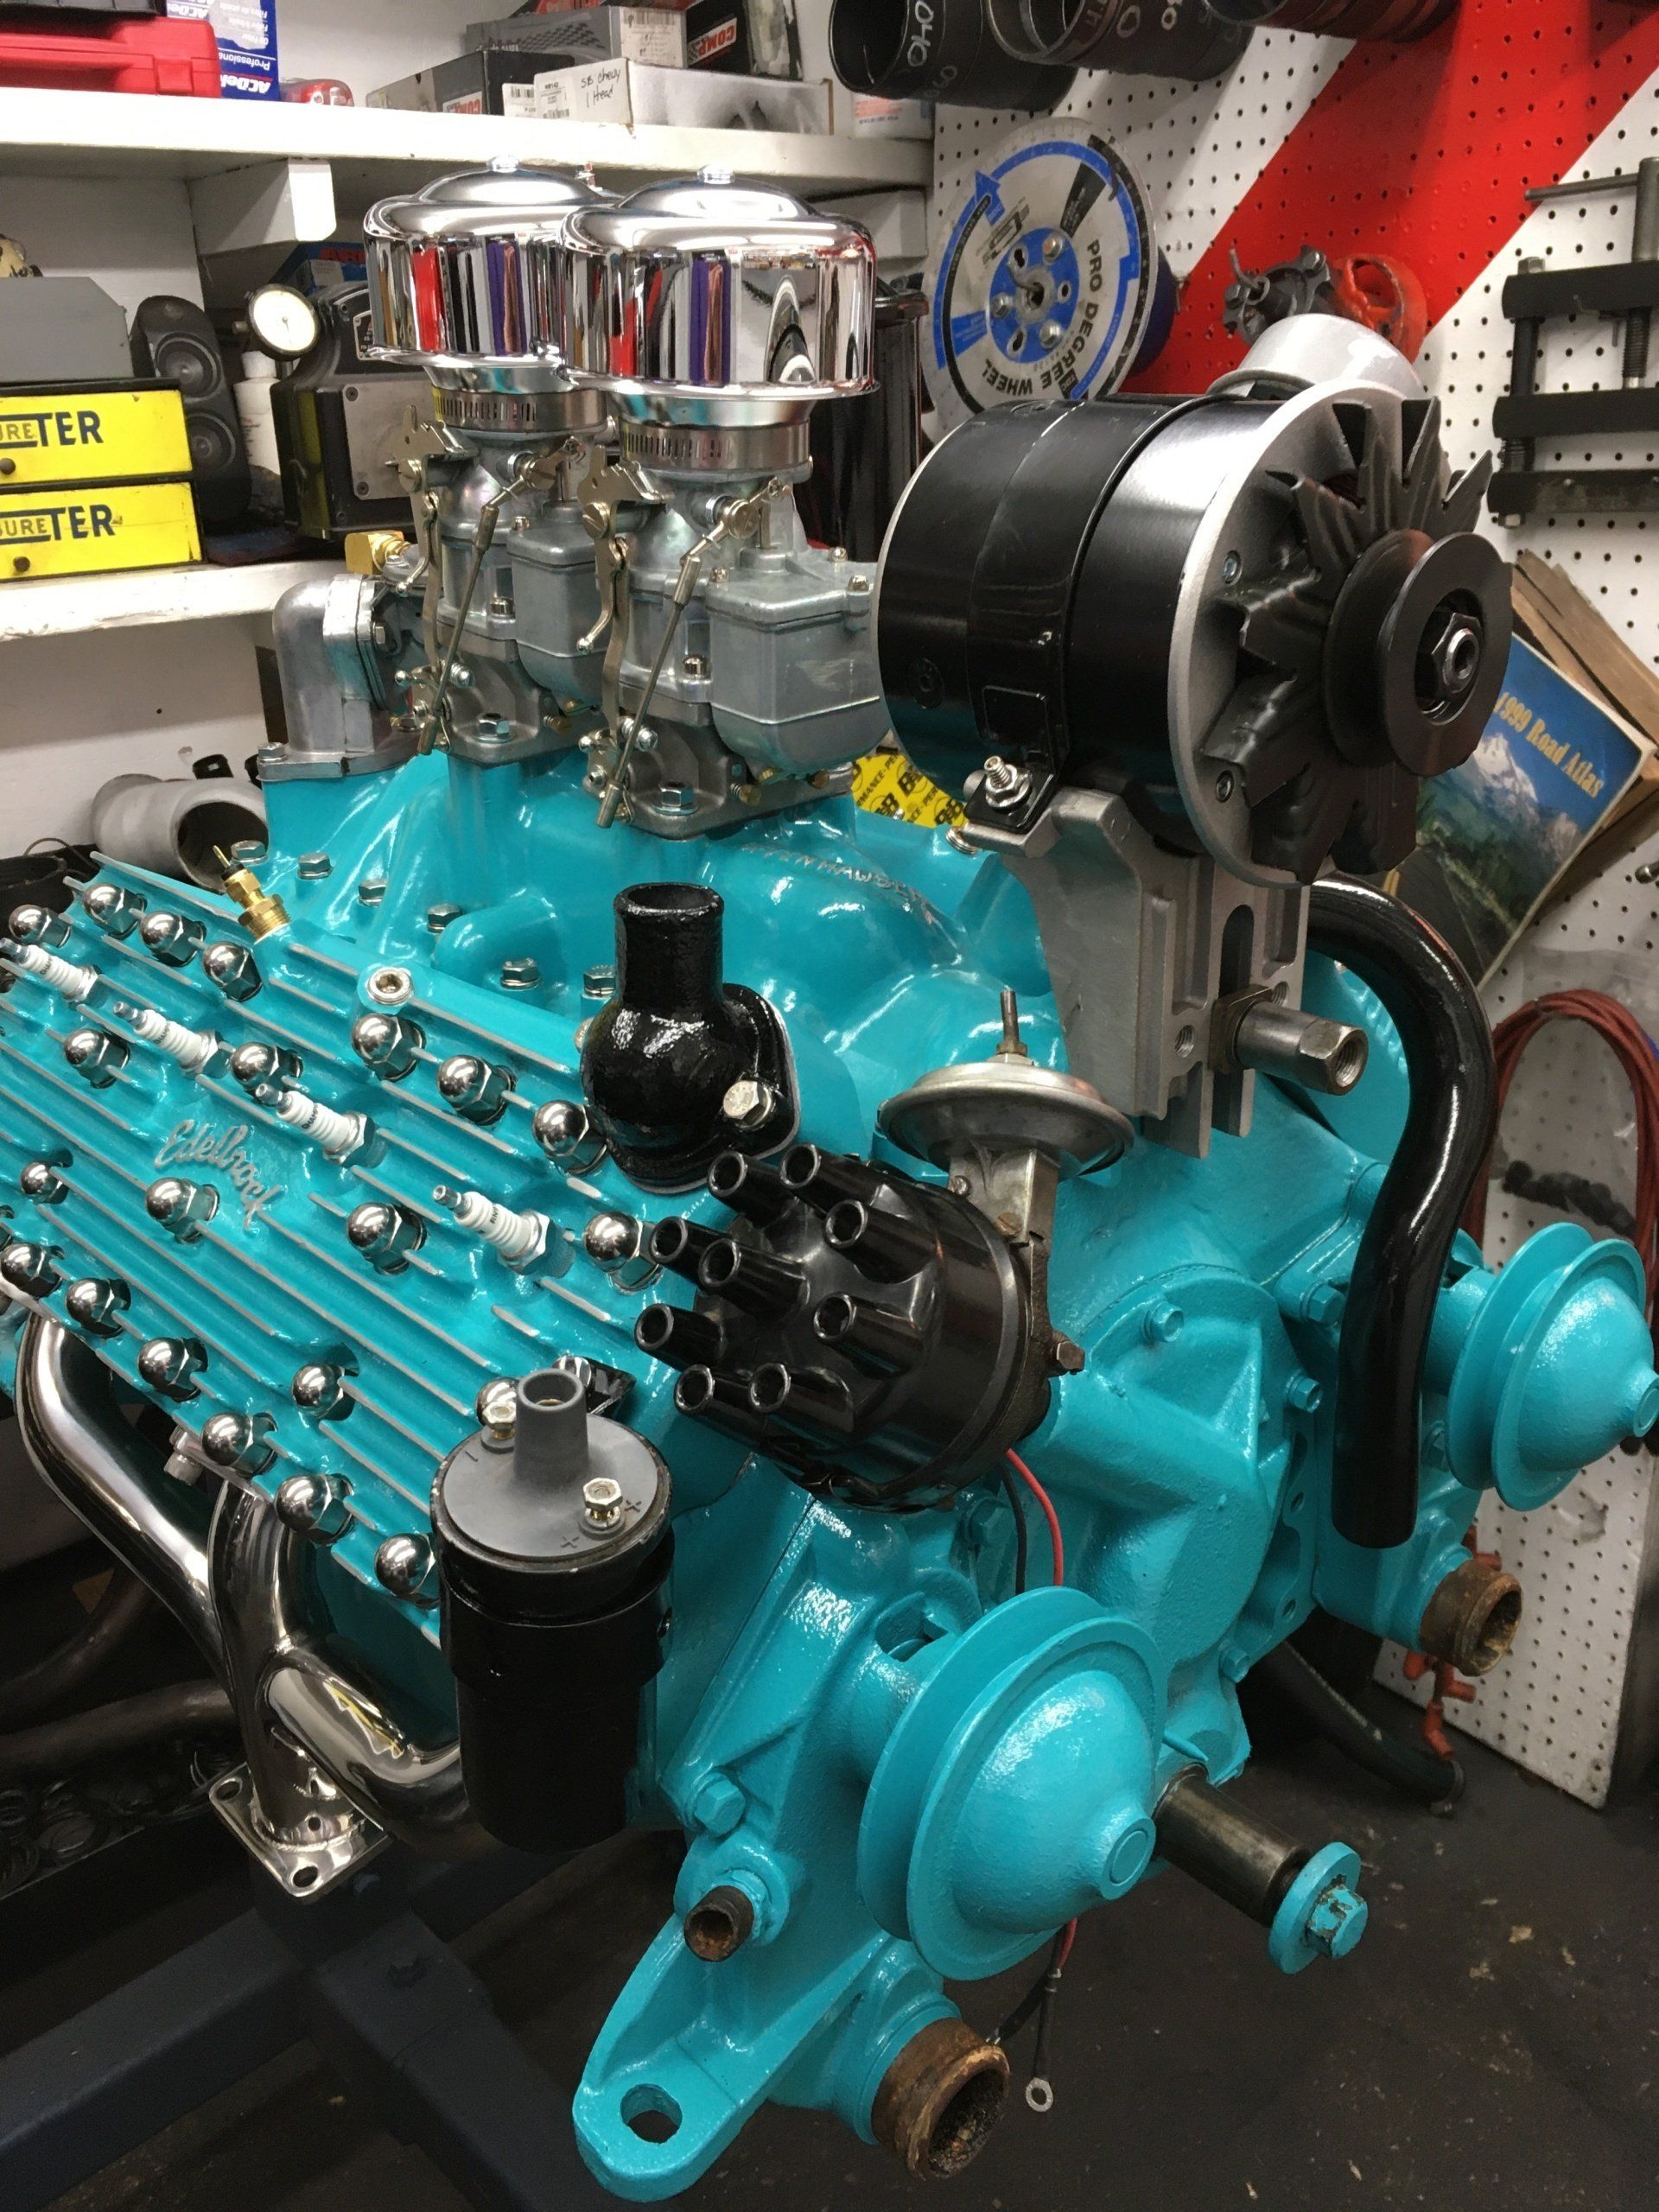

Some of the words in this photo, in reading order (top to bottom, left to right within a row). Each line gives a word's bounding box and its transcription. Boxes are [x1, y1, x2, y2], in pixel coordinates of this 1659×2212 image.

[698, 24, 734, 55] COMP
[593, 84, 613, 106] Head
[1086, 239, 1103, 292] PRO
[1040, 302, 1099, 390] DEGREE
[982, 358, 1033, 397] WHEEL
[1526, 718, 1571, 766] Road
[1561, 752, 1605, 798] Atlas
